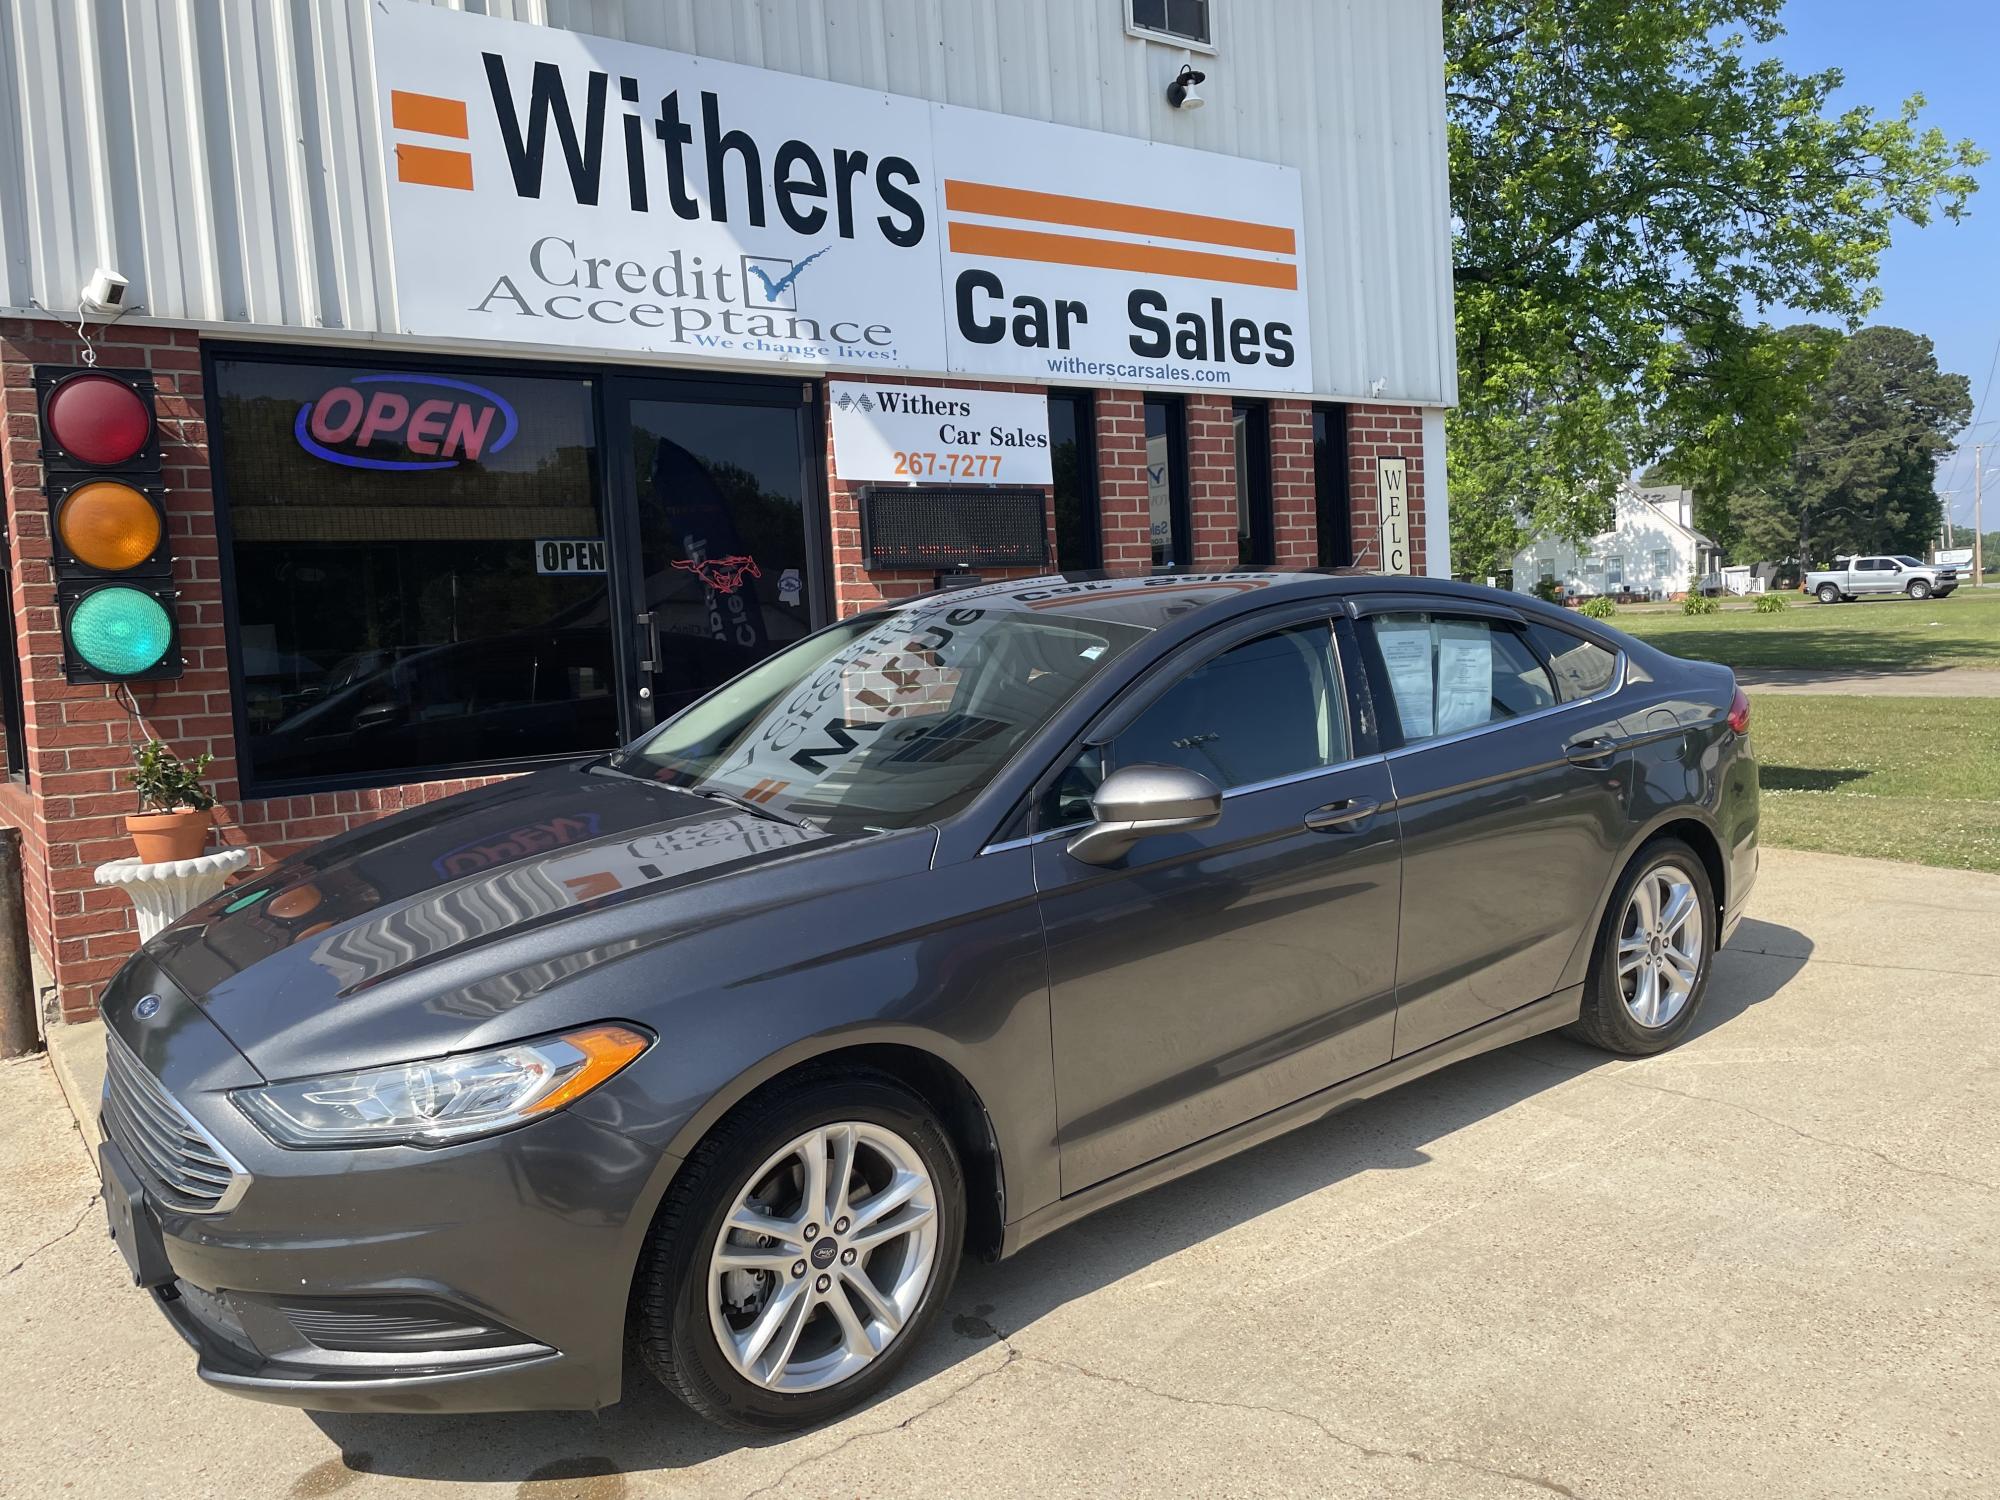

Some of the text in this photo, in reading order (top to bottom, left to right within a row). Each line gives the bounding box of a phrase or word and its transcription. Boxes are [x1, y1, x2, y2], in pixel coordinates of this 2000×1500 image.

[482, 51, 924, 248] Withers
[530, 236, 735, 302] Credit
[467, 275, 893, 346] Acceptance
[956, 269, 1295, 368] Car Sales
[694, 334, 898, 361] We change lives!
[1047, 356, 1231, 383] witherscarsales.com
[876, 391, 971, 417] Withers
[311, 387, 495, 460] OPEN
[939, 424, 1047, 448] Car Sales
[893, 452, 1002, 477] 267-7277
[542, 542, 605, 571] OPEN
